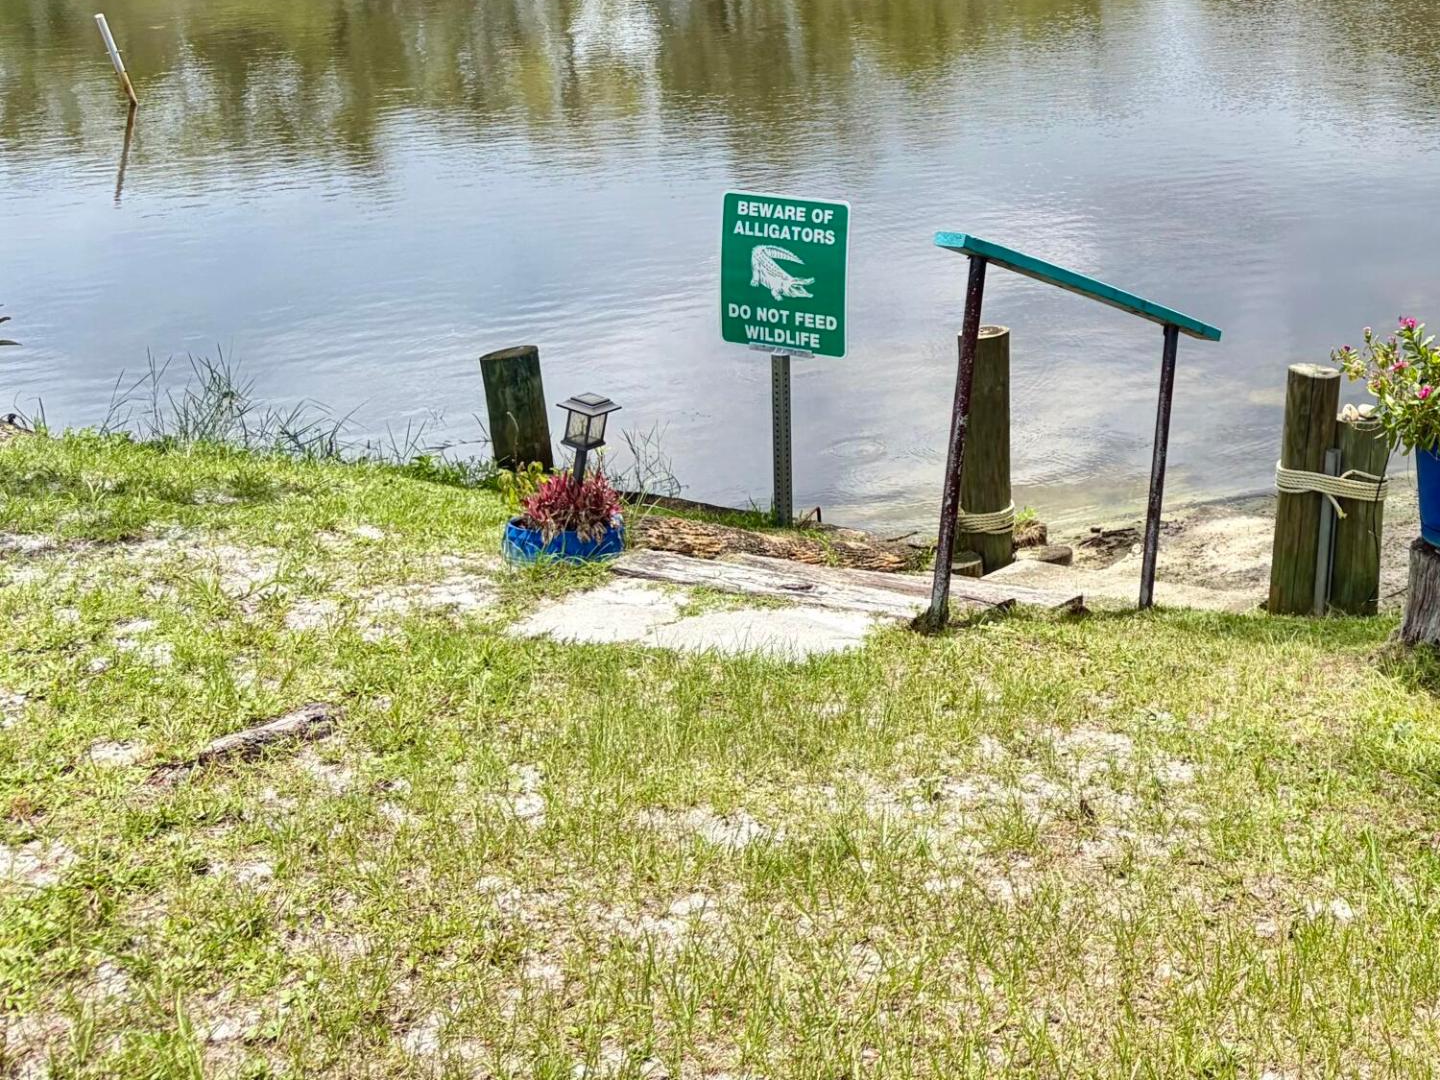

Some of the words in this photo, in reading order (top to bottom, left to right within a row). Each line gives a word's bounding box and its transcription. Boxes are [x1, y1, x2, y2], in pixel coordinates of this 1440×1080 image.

[737, 201, 806, 222] BEWARE
[812, 208, 834, 224] OF
[733, 220, 836, 245] ALLIGATORS
[728, 303, 751, 319] DO
[757, 307, 789, 324] NOT
[795, 312, 837, 331] FEED
[745, 324, 820, 348] WILDLIFE
